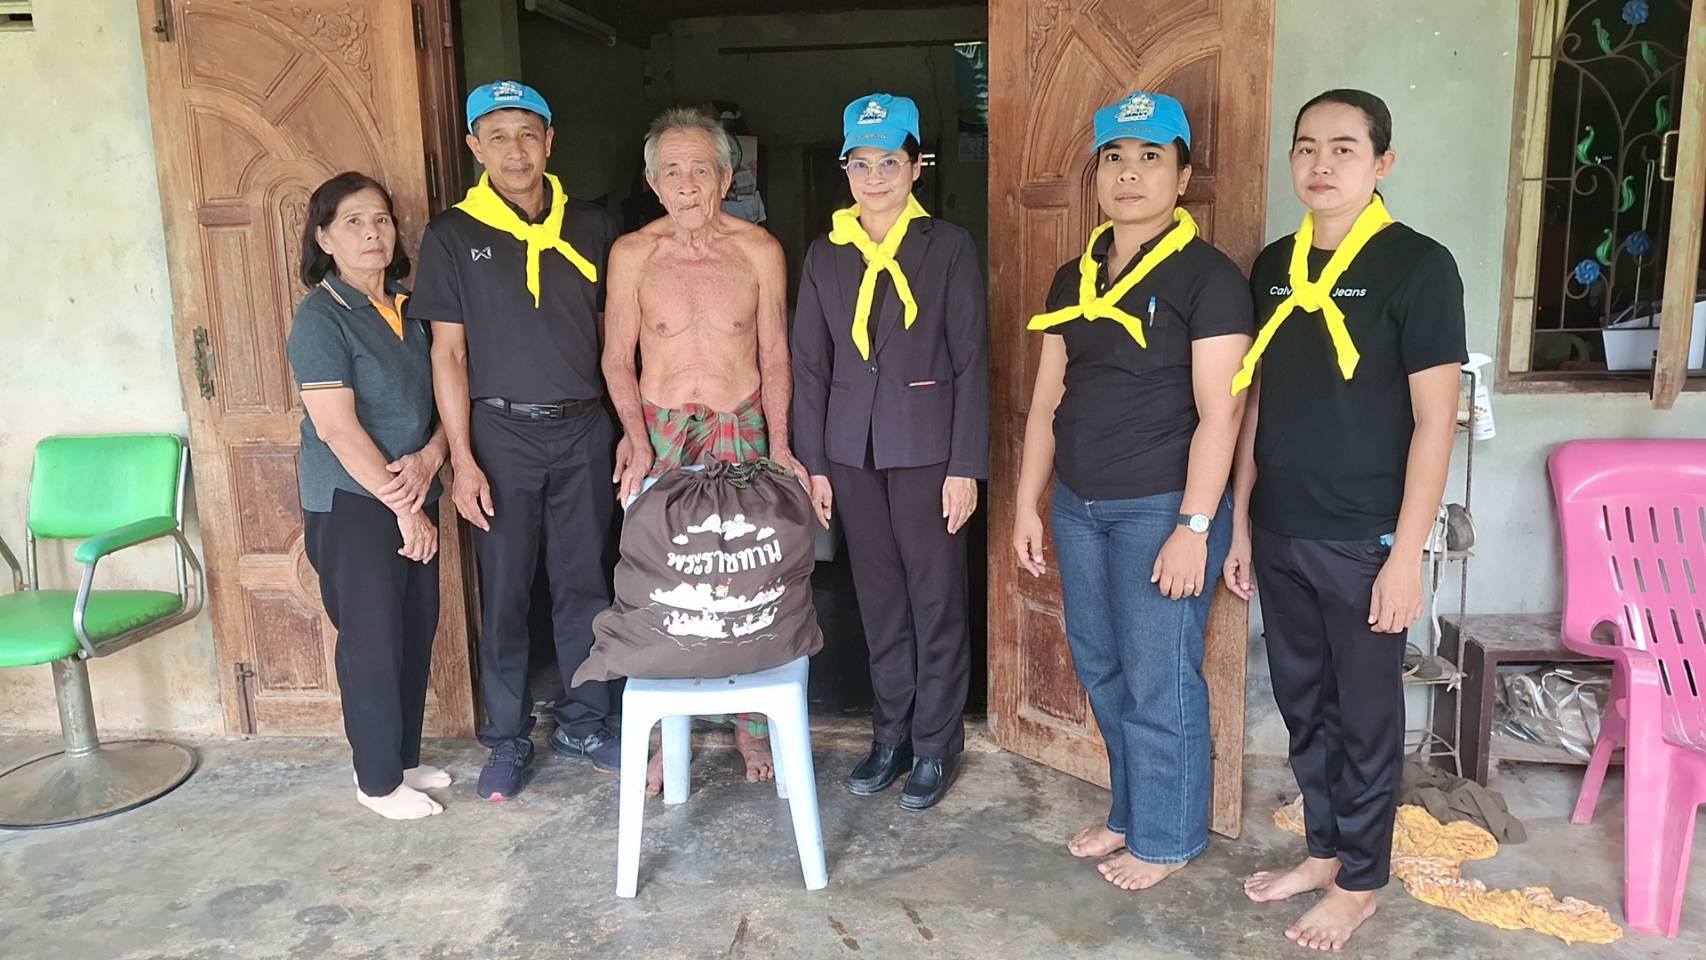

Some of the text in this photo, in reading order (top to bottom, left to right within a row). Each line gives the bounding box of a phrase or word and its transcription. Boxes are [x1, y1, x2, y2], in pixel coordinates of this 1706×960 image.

[1269, 286, 1367, 298] Calv Jeans
[667, 539, 783, 575] พระราชทาน
